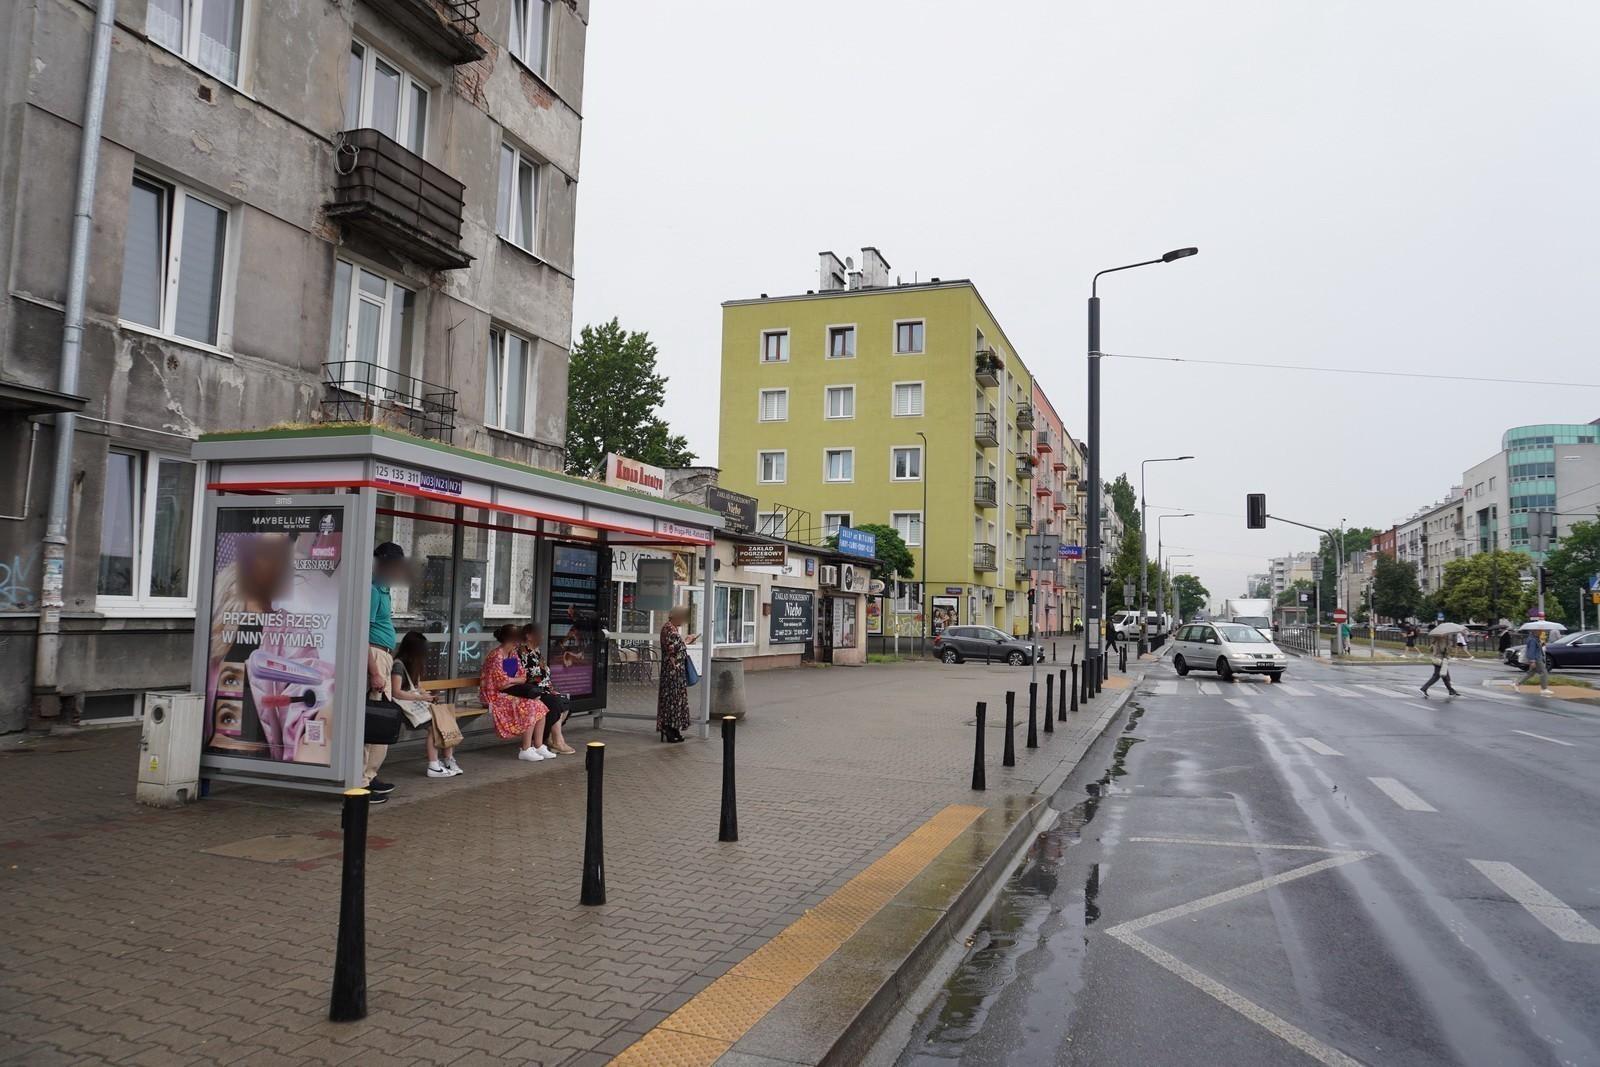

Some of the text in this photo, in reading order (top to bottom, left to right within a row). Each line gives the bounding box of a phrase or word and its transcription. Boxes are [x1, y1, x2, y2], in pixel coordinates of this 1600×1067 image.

[375, 465, 461, 491] 125 135 311 N03 N21 N71
[252, 516, 311, 525] MAYBELLINE
[784, 602, 803, 617] Niebo
[223, 610, 284, 628] PRZENIEŚ
[222, 630, 323, 648] W INNY WYMIAR
